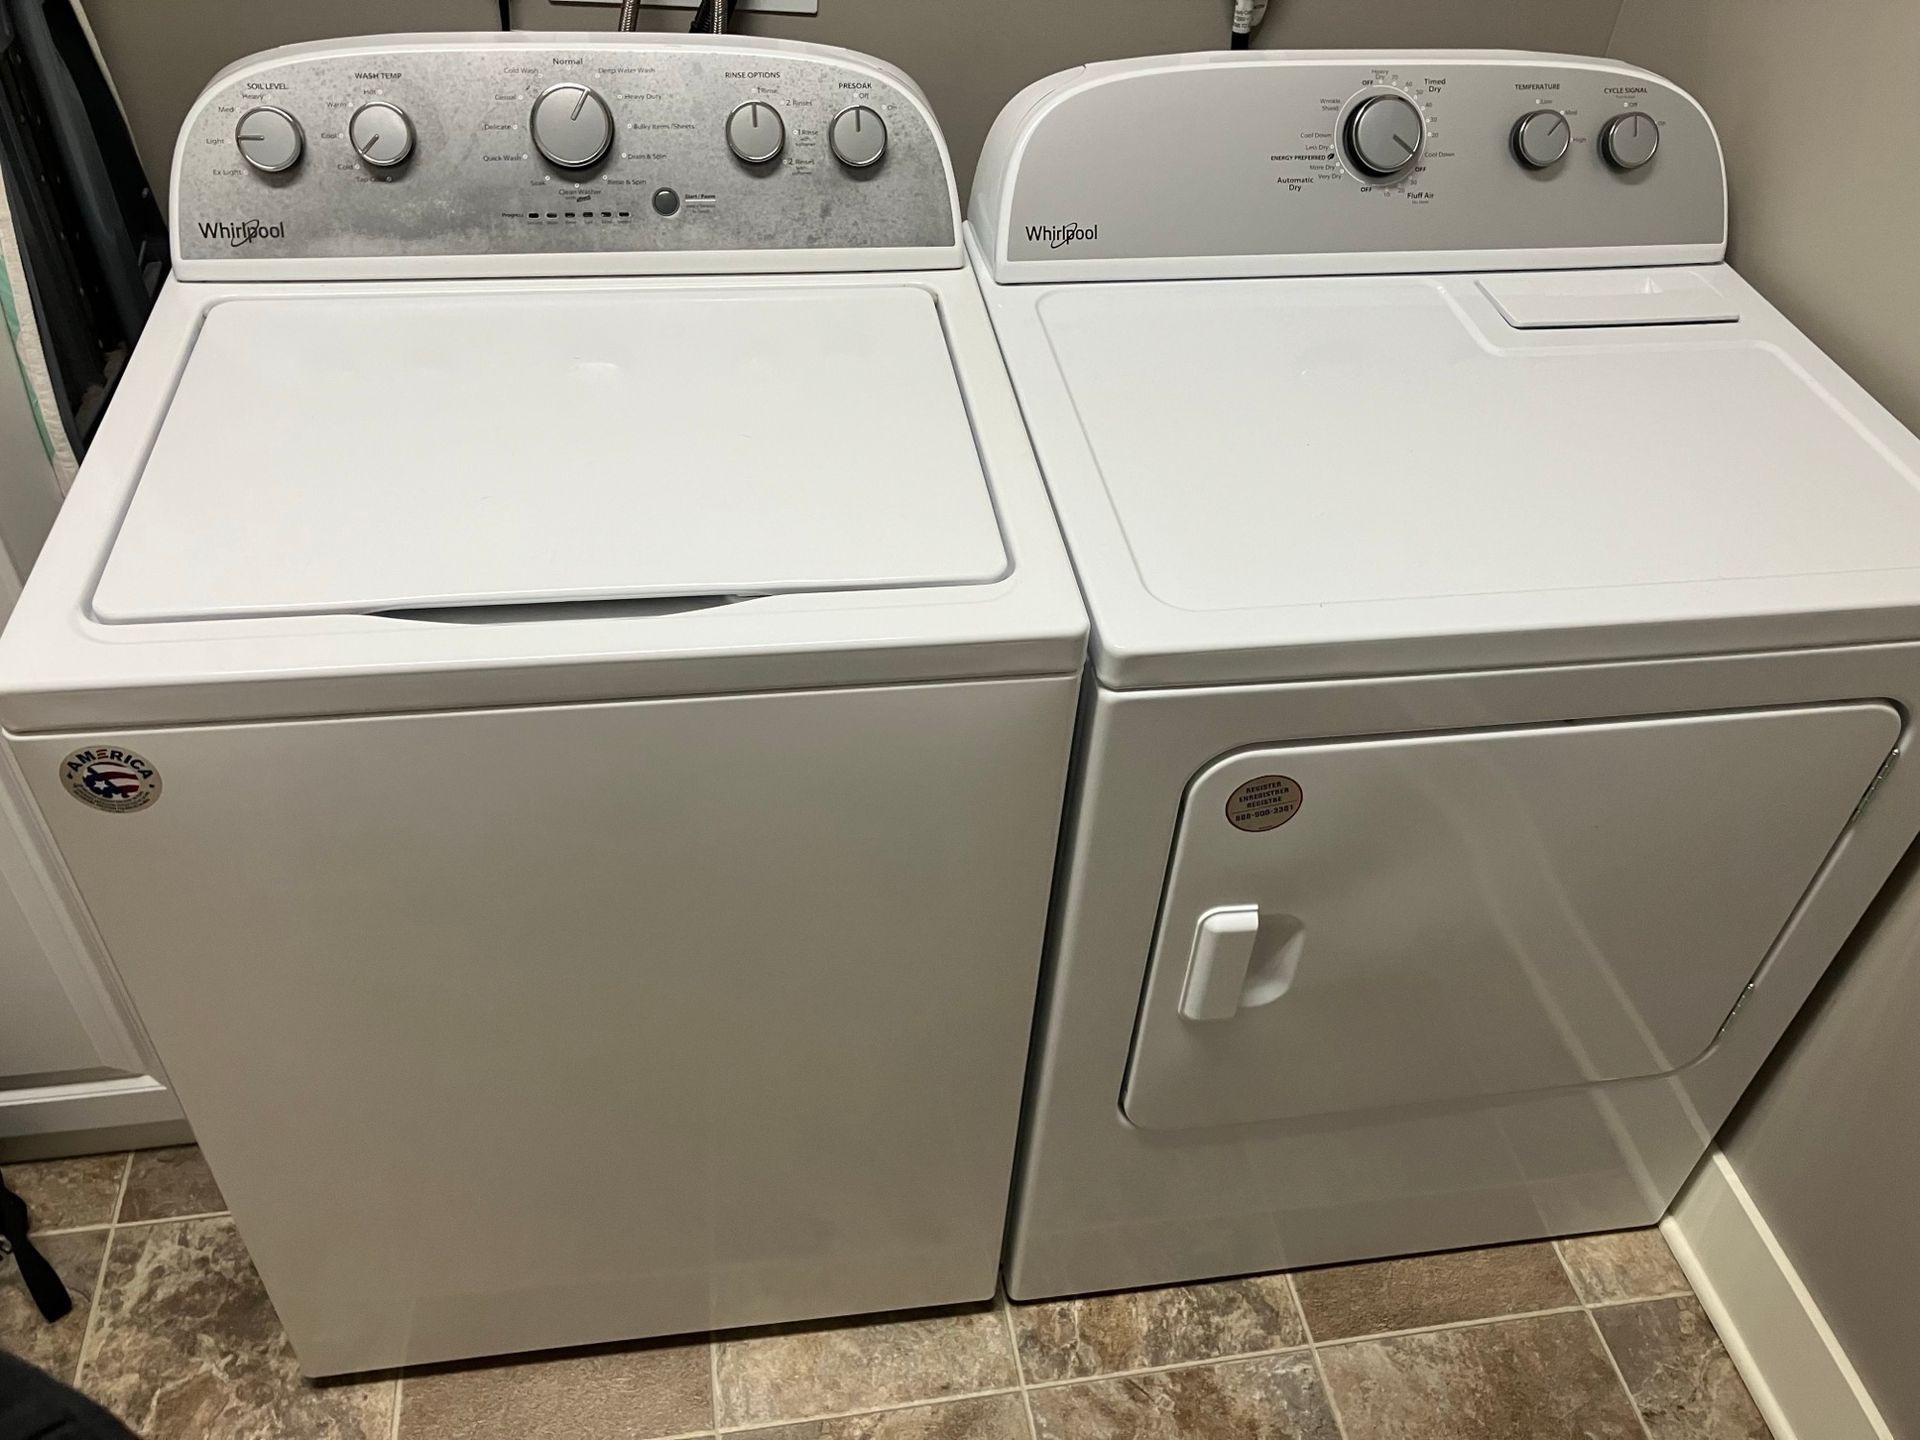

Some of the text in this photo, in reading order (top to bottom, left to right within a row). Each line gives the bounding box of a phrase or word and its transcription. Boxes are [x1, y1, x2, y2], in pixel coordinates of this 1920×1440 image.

[1288, 184, 1302, 192] Dry
[198, 219, 285, 247] Whirlpool
[1025, 222, 1098, 248] Whirlpool
[67, 749, 154, 780] AMERICA
[1246, 781, 1282, 794] REGISTER
